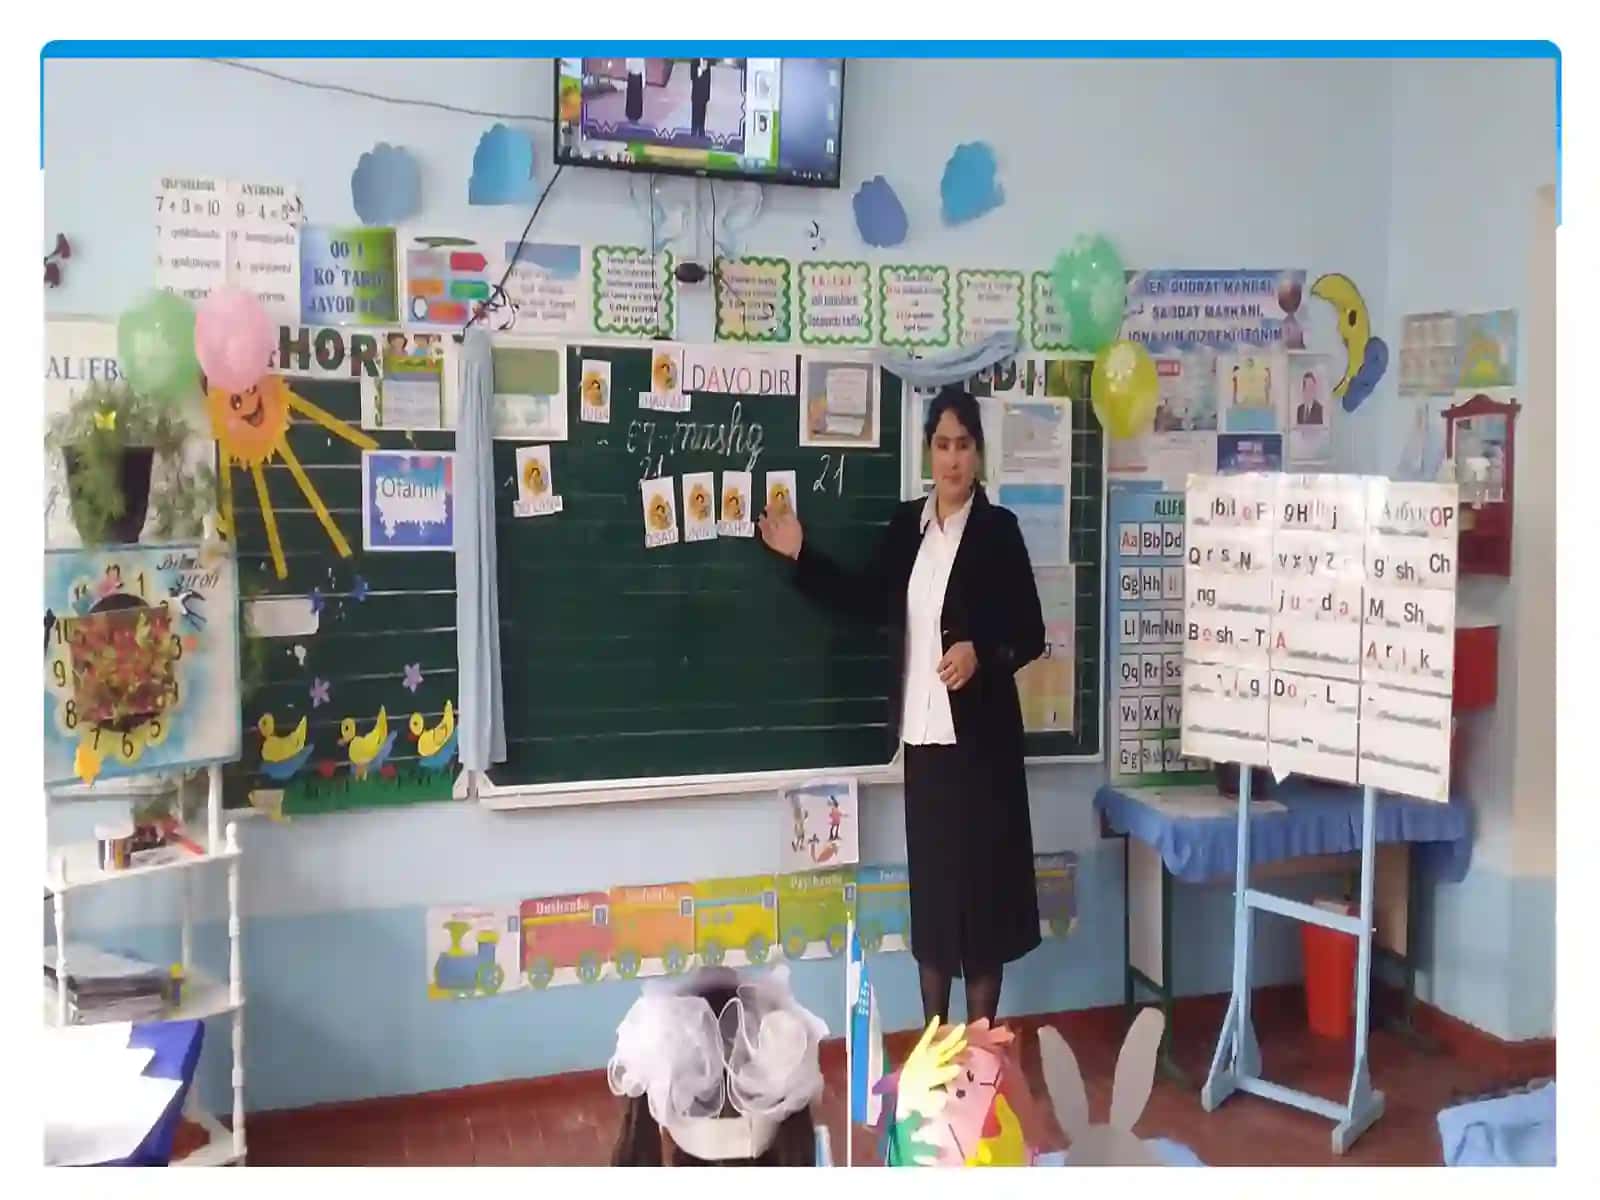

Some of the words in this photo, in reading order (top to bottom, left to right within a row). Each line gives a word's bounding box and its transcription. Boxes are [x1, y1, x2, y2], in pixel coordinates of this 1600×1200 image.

[155, 196, 164, 212] 7
[208, 199, 220, 217] 10
[236, 202, 245, 217] 9
[45, 356, 127, 381] ALIFB
[812, 455, 845, 495] 21
[1122, 531, 1137, 547] Aa
[1144, 531, 1160, 549] Bb
[1165, 531, 1181, 548] Dd
[1188, 547, 1201, 565] Q
[1396, 560, 1415, 582] sh
[1429, 553, 1451, 574] Ch
[1122, 576, 1138, 594] Gg
[1143, 576, 1160, 592] Hh
[1198, 588, 1216, 607] ng
[1369, 597, 1384, 619] M
[1403, 602, 1424, 624] Sh
[1142, 619, 1161, 635] Mm
[1164, 619, 1182, 635] Nn
[170, 634, 182, 660] 3
[1276, 631, 1287, 649] A
[53, 660, 65, 687] 9
[1122, 663, 1138, 682] Qq
[1144, 662, 1158, 678] Rr
[1165, 661, 1181, 677] Ss
[65, 699, 77, 729] 8
[1122, 706, 1137, 721] Vv
[1144, 705, 1160, 720] Xx
[90, 728, 100, 751] 7
[121, 733, 134, 758] 6
